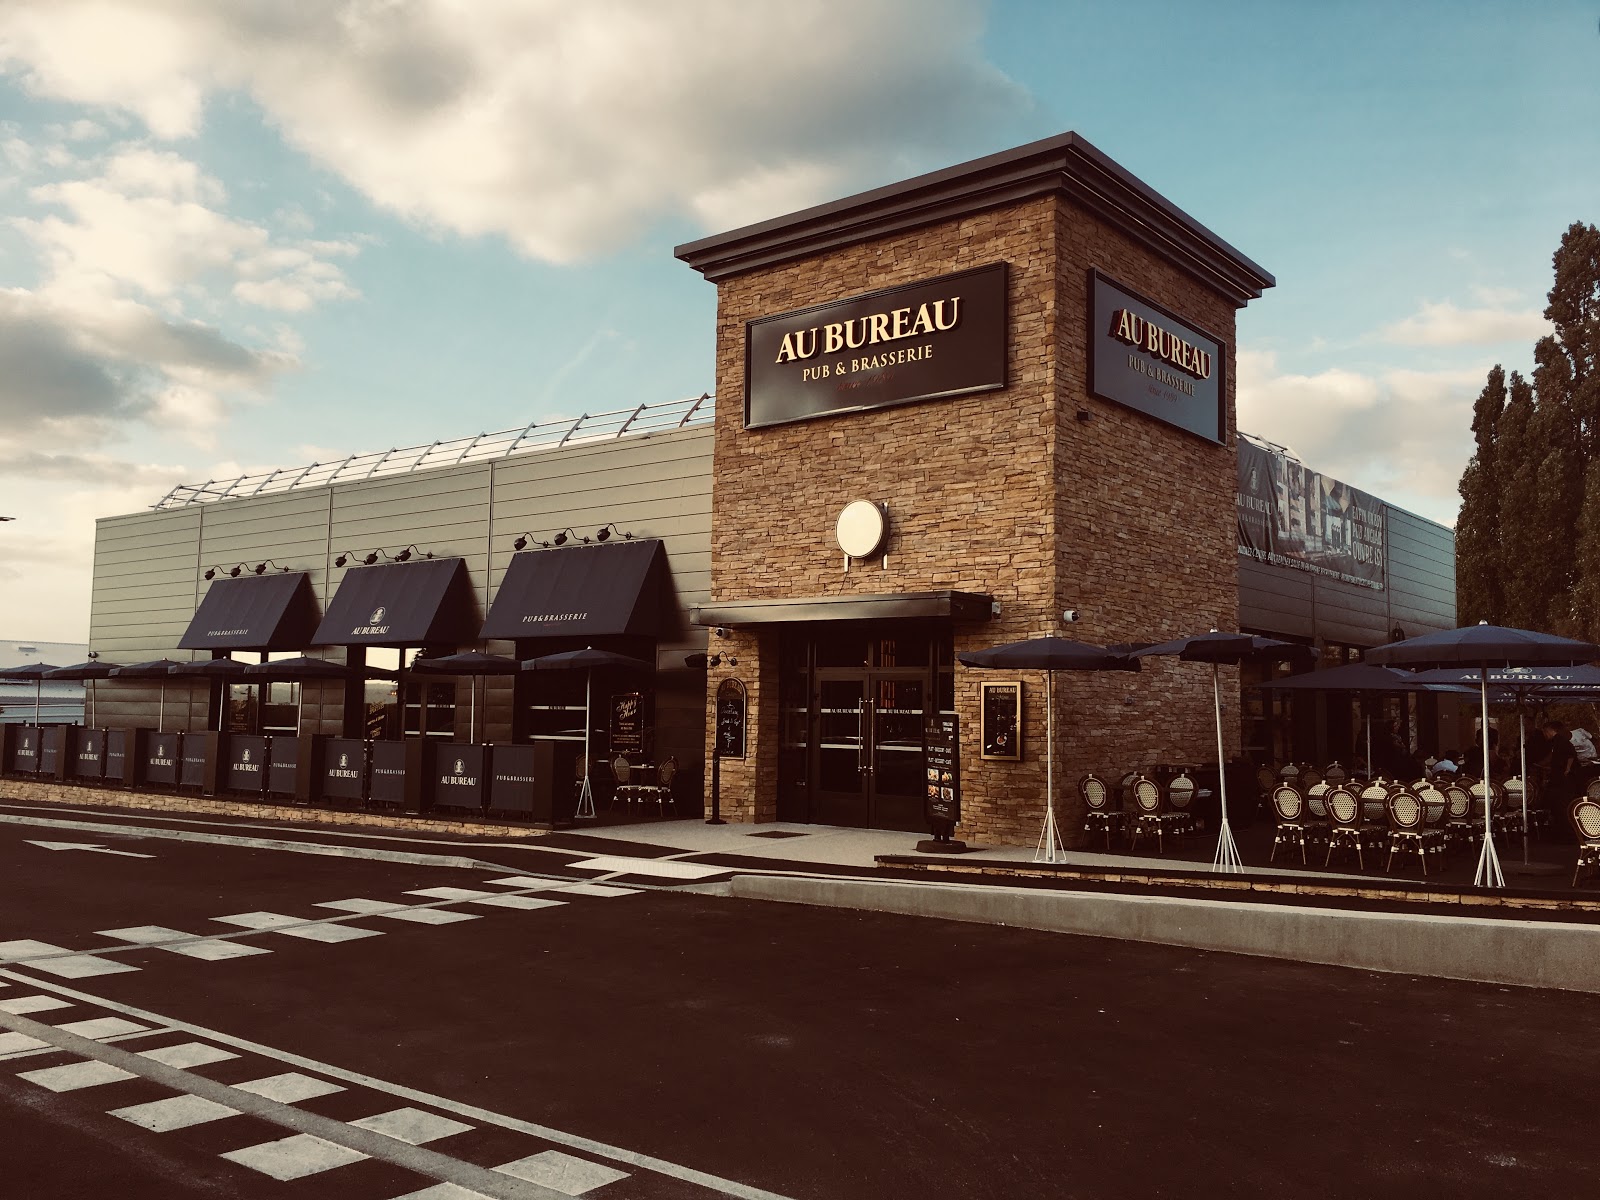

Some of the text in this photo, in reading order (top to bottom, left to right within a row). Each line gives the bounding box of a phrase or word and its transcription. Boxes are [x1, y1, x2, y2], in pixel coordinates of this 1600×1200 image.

[775, 297, 960, 363] AU BUREAU
[1117, 309, 1212, 379] AU BUREAU
[802, 345, 933, 381] PUB & BRASSERIE
[1128, 354, 1196, 397] PUB & BRASSERIE
[351, 625, 390, 635] AU BUREAU
[239, 763, 260, 772] BUREAU
[328, 769, 359, 779] AU BUREAU
[440, 776, 477, 786] AU BUREAU
